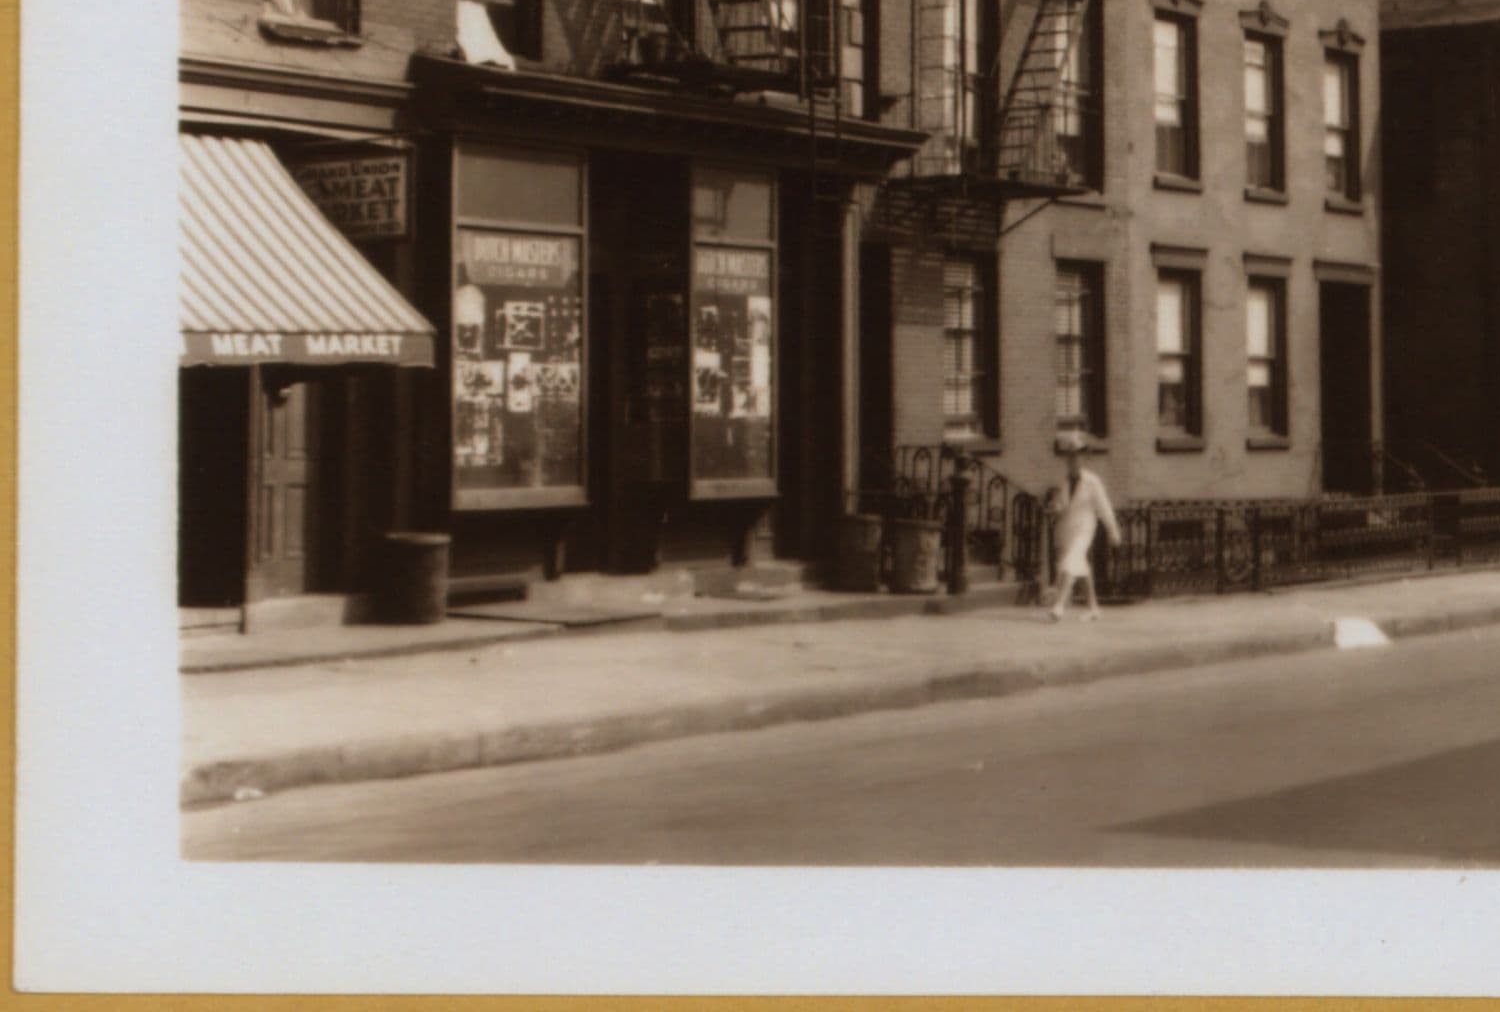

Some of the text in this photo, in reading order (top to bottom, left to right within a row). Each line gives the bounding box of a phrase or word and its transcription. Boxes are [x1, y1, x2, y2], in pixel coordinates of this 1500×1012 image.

[512, 240, 561, 267] MASTERS
[488, 266, 548, 282] CIGARS
[210, 334, 403, 356] MEAT MARKET
